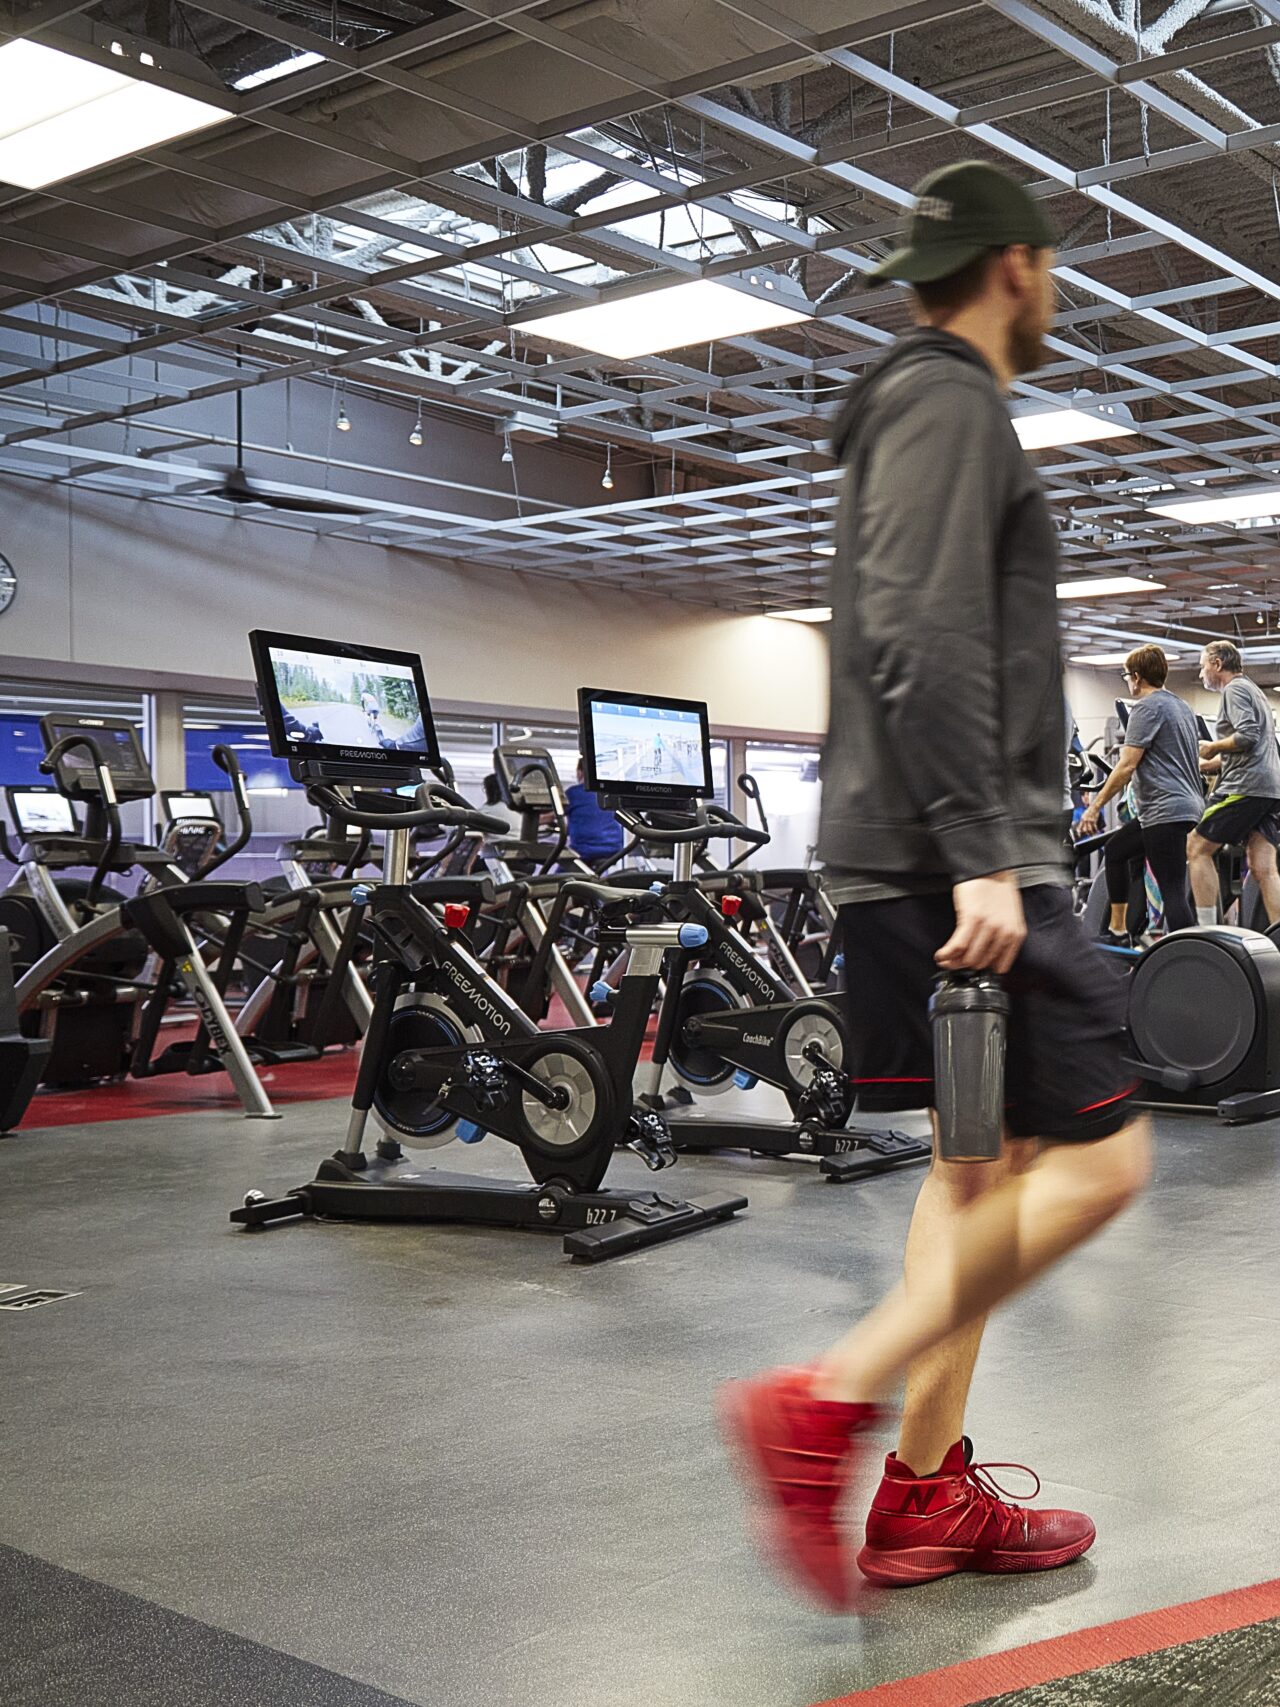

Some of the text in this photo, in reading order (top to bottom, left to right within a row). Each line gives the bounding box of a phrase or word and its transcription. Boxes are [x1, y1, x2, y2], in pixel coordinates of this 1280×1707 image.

[340, 750, 388, 760] FREEMOTION
[441, 961, 511, 1035] FREEMOTION
[719, 942, 776, 1001] FREEMOTION
